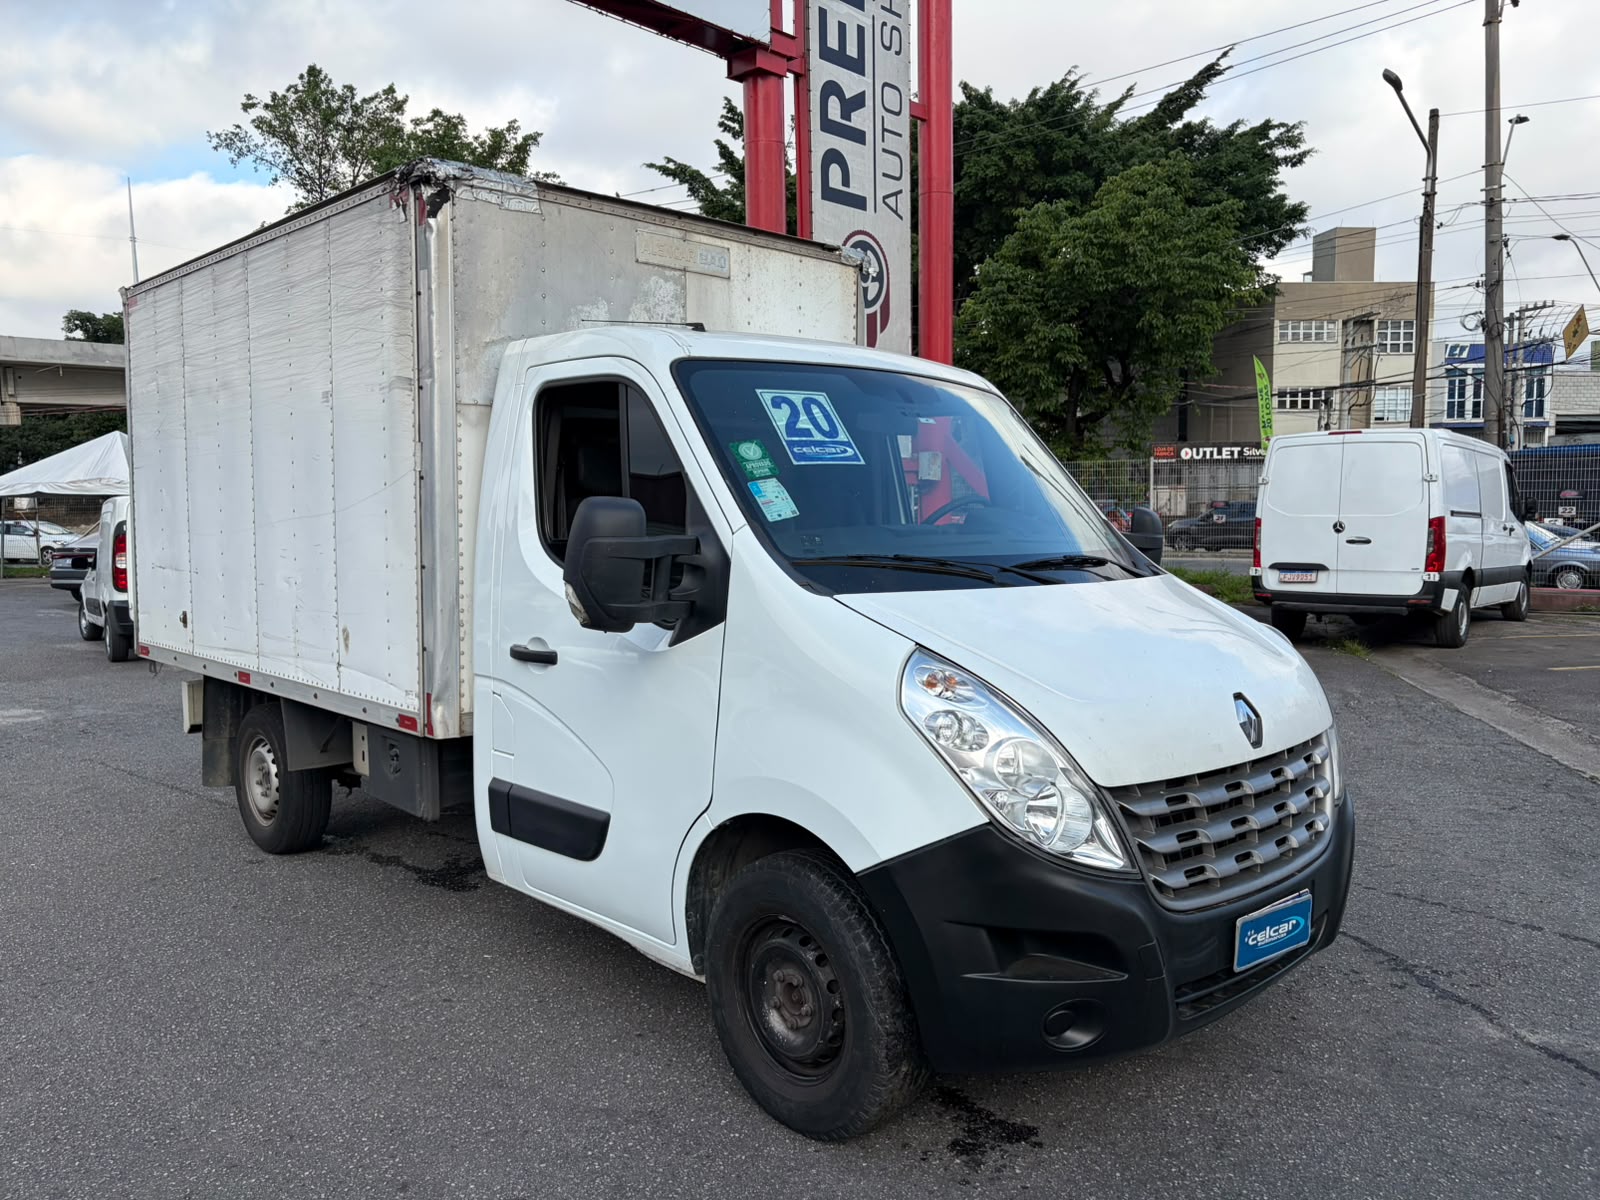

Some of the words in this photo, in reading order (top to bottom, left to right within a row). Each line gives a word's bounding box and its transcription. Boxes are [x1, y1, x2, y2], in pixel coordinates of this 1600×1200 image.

[818, 0, 867, 211] PRE
[881, 81, 903, 220] AUTO
[770, 395, 840, 440] 20
[792, 445, 844, 454] celcar
[1180, 447, 1242, 460] OUTLET
[1248, 919, 1297, 945] celcar
